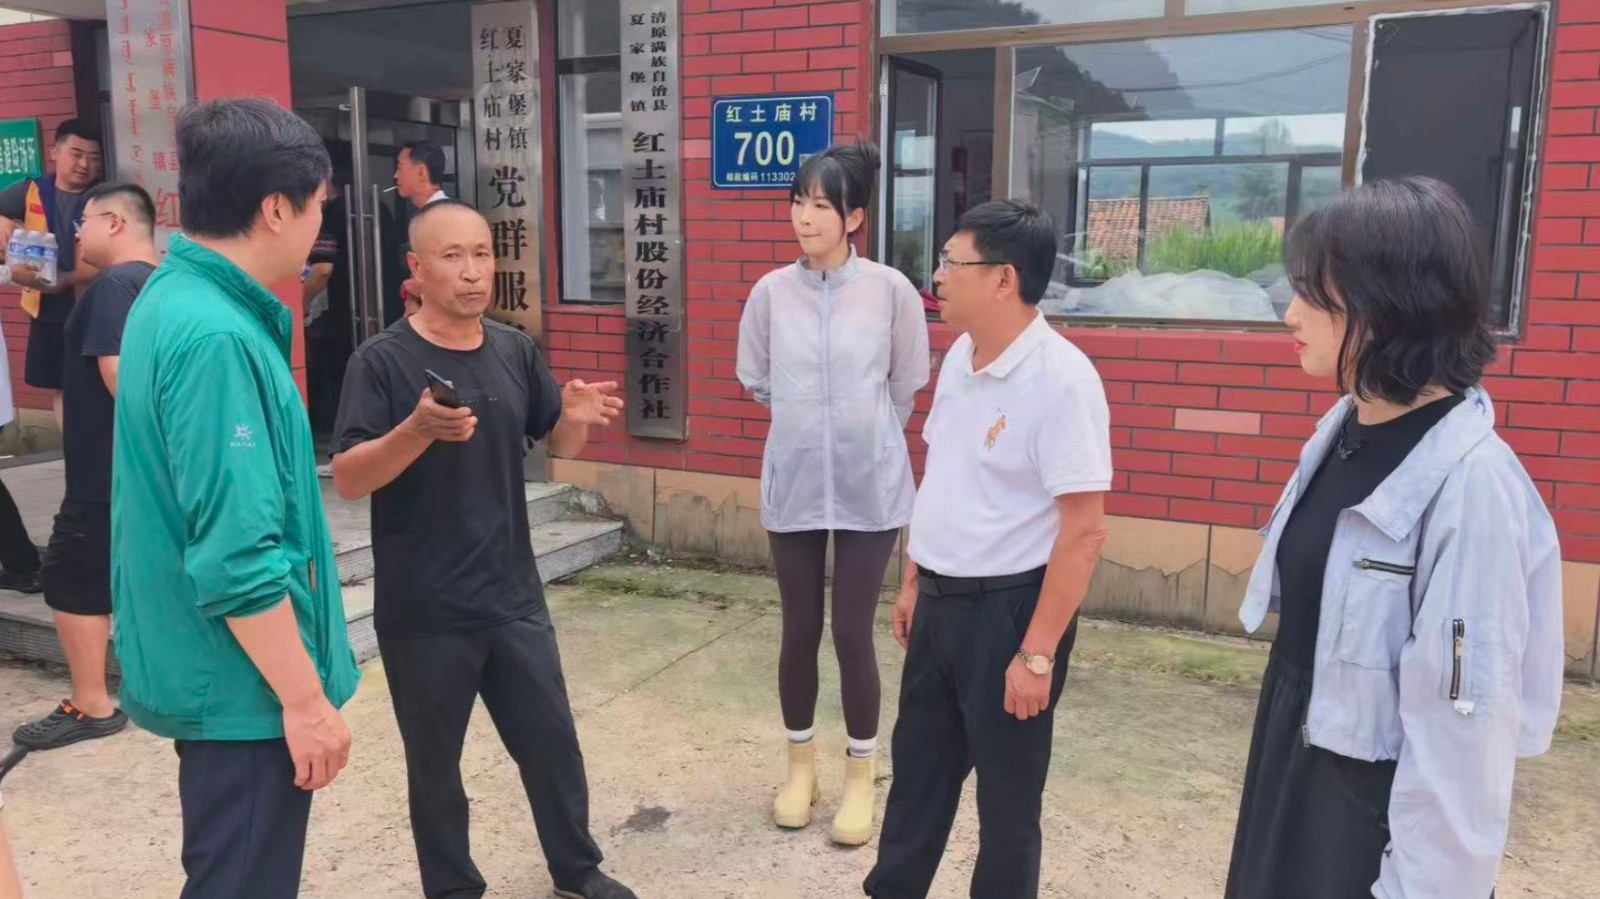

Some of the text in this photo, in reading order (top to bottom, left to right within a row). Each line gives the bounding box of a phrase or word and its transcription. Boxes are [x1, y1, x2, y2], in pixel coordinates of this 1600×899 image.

[480, 28, 501, 151] 红土庙村
[505, 25, 528, 150] 夏家堡镇
[629, 13, 647, 112] 夏家堡镇
[650, 11, 667, 111] 清原满族自治县
[726, 102, 817, 122] 红土庙村
[734, 130, 795, 166] 700
[760, 171, 796, 182] 113302
[489, 165, 529, 330] 党群服
[631, 131, 673, 420] 红土庙村股份经济合作社
